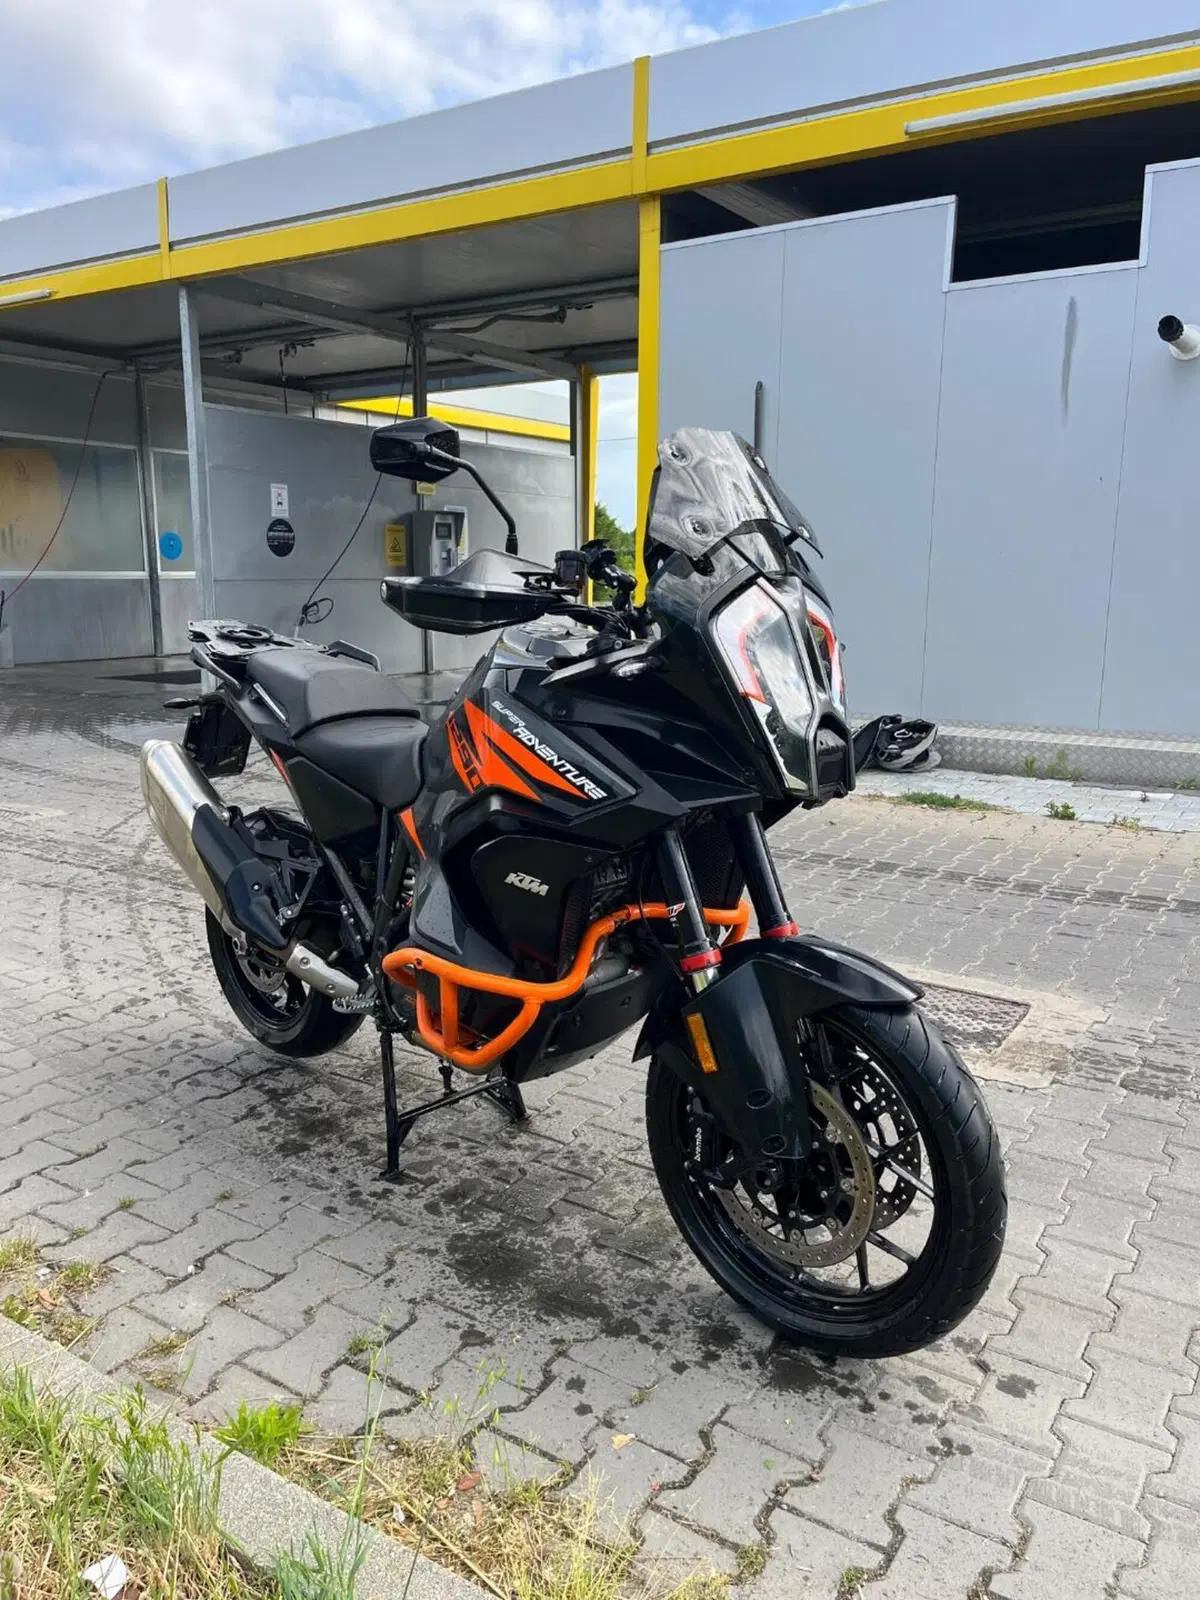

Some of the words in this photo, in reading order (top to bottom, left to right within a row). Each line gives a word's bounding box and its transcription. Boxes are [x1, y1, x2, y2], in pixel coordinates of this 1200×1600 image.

[491, 700, 526, 728] SUPER
[512, 726, 608, 800] ADVENTURE
[504, 871, 549, 897] KTM
[693, 1127, 702, 1162] brembo
